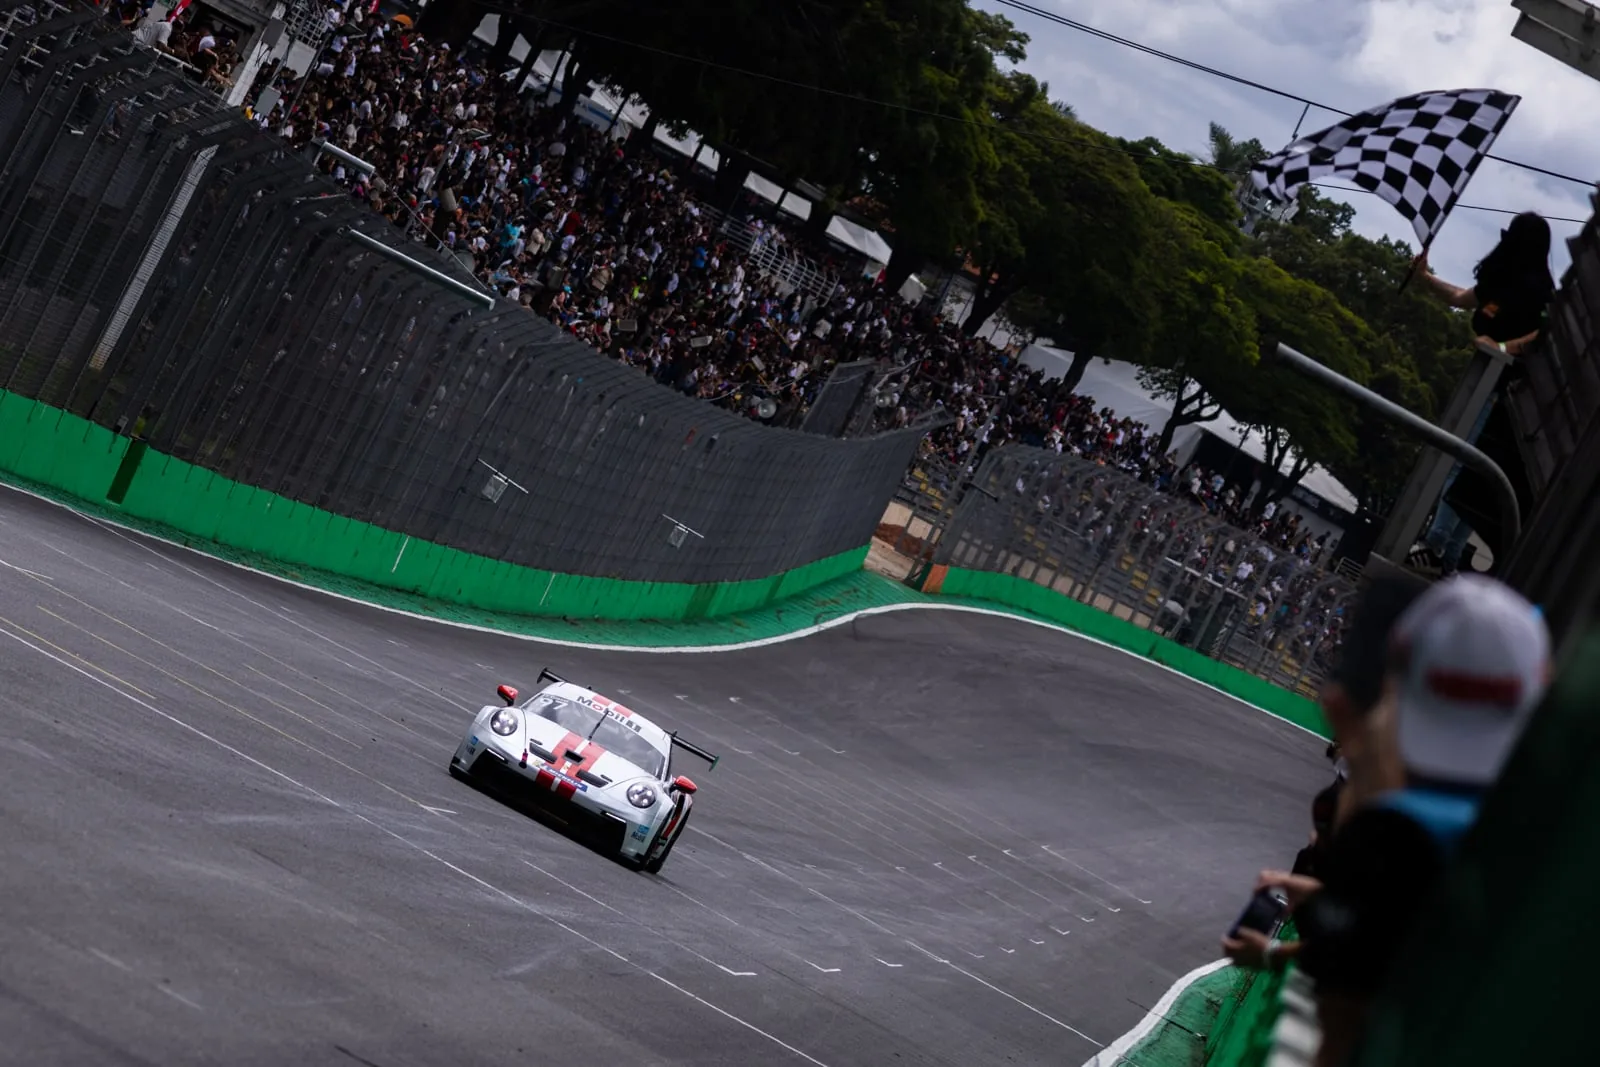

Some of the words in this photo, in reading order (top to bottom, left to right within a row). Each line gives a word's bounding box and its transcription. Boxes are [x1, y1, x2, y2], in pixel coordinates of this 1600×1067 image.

[540, 698, 568, 710] 97
[577, 696, 625, 722] Mobil
[549, 769, 584, 789] MICHELIN
